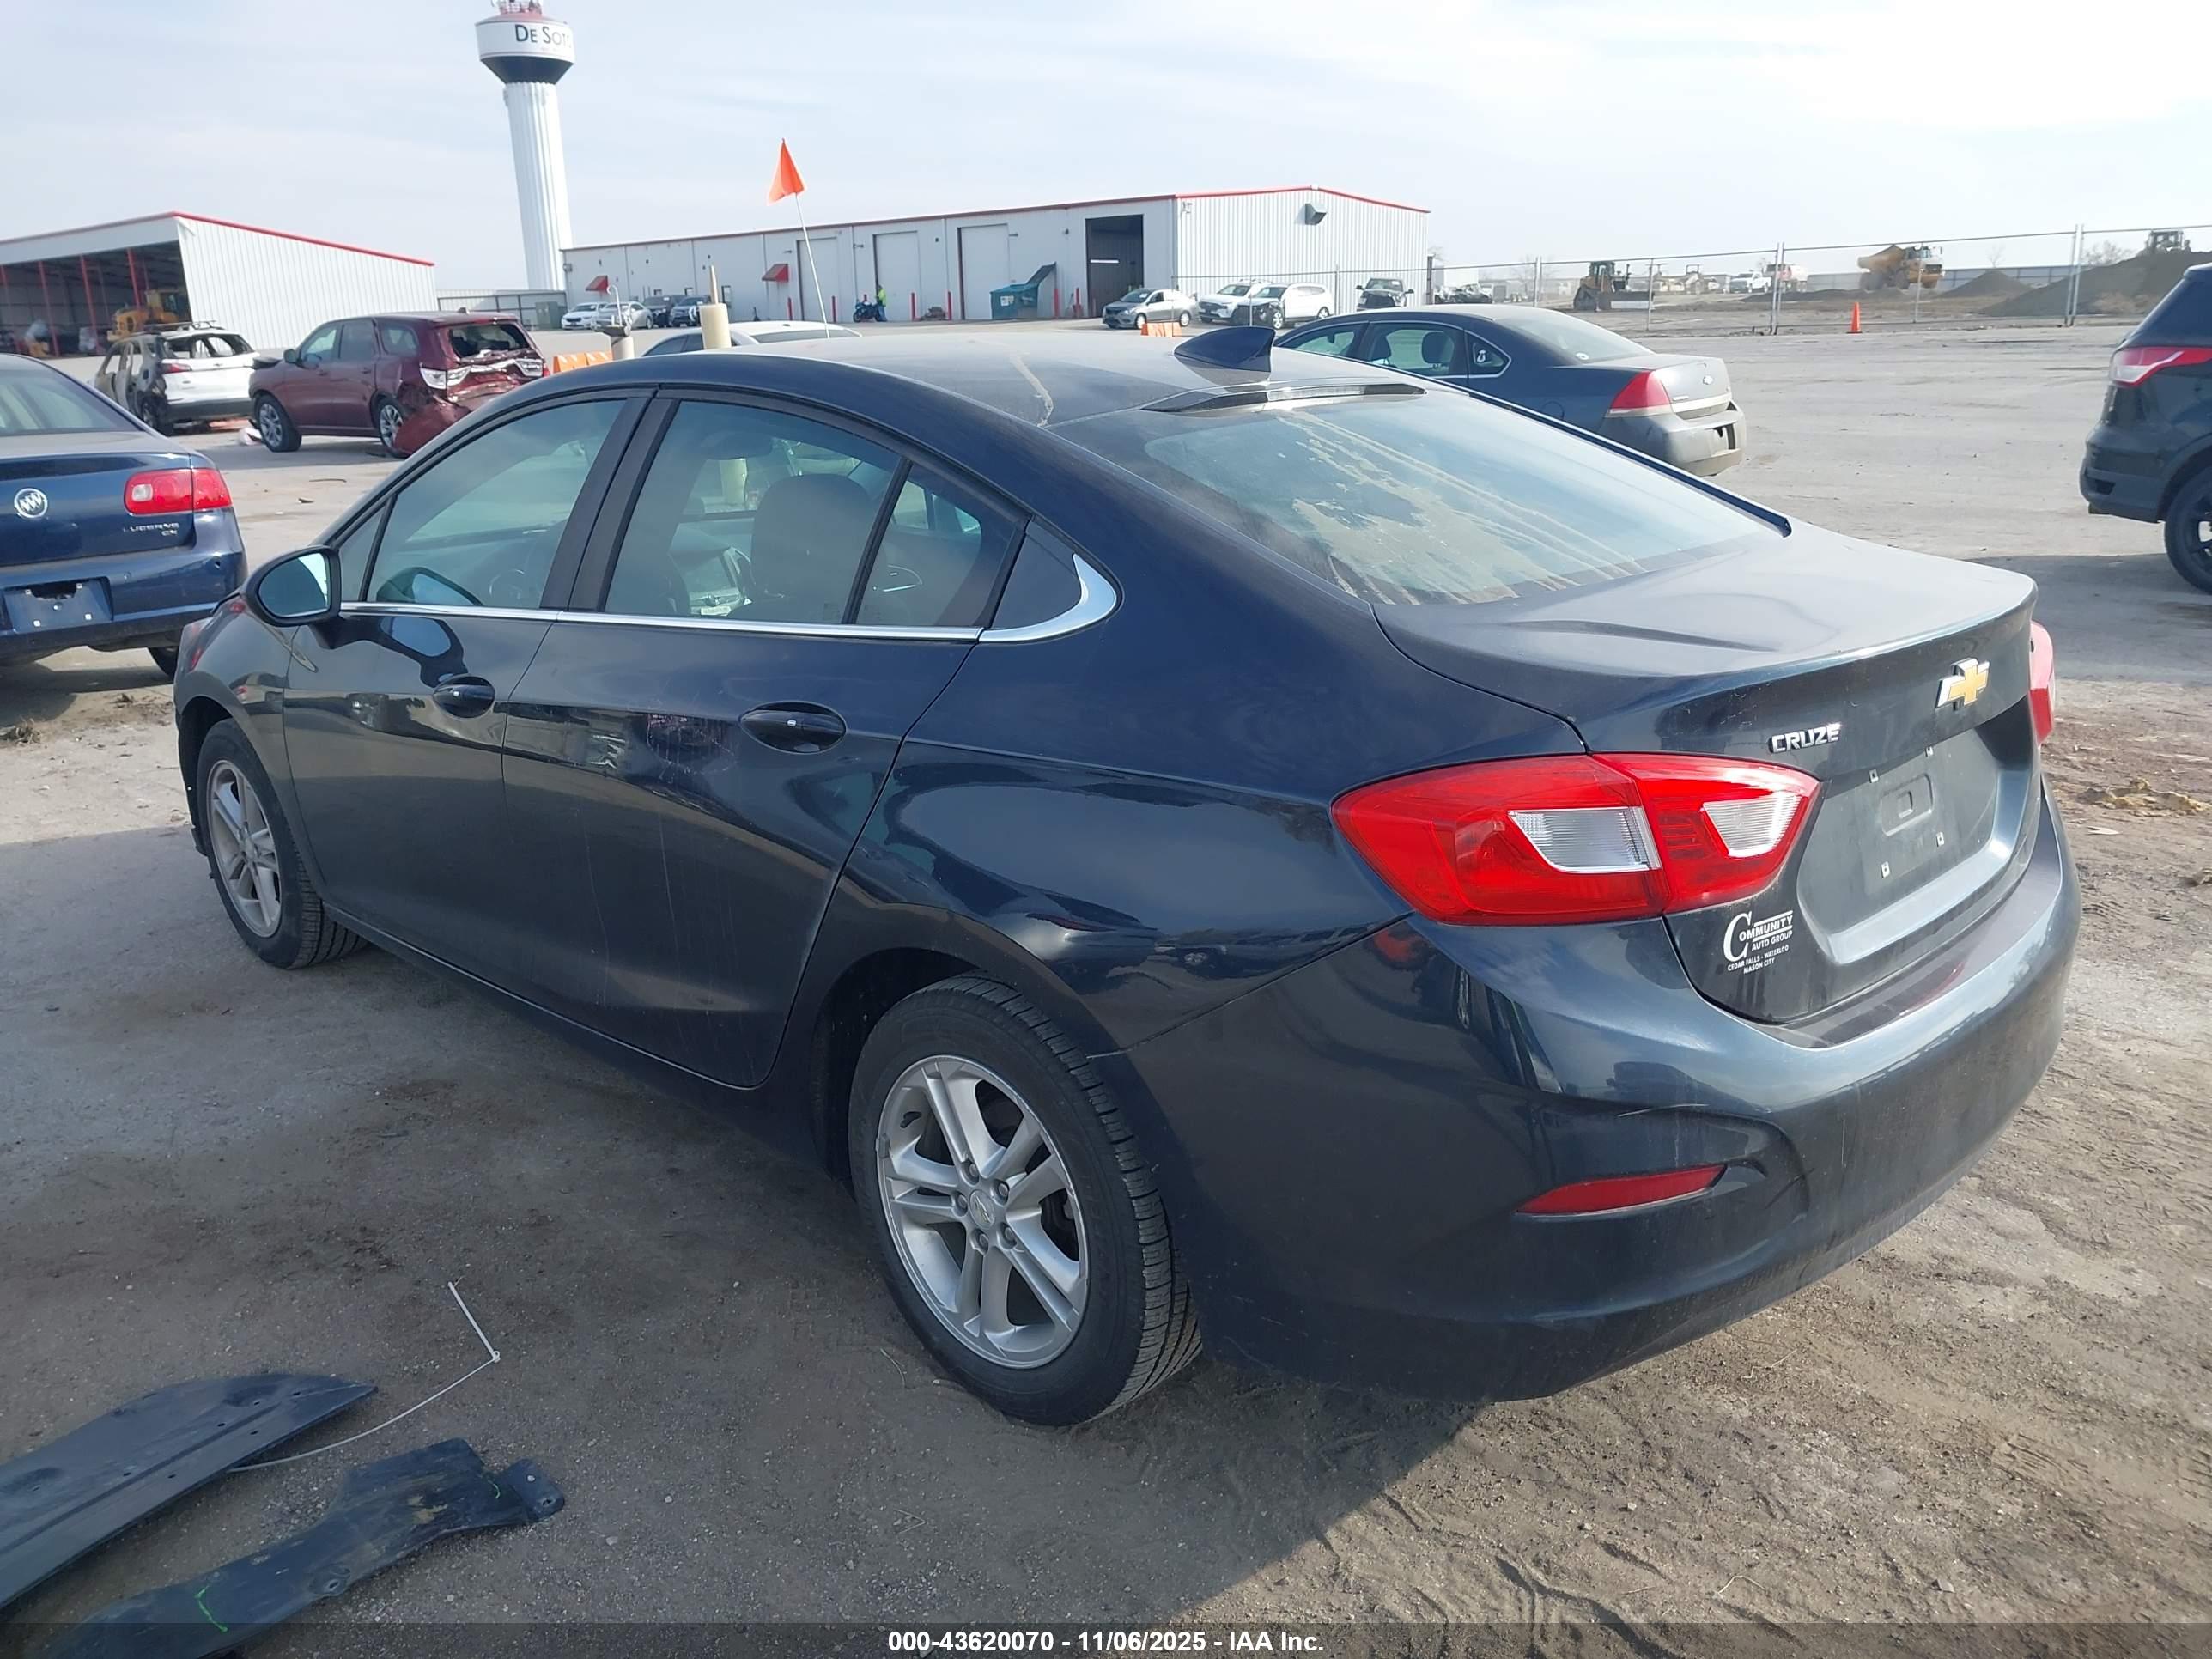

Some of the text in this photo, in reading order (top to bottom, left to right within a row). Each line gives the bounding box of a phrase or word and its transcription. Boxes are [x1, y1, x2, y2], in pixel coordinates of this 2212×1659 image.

[1769, 722, 1841, 753] CRUZE
[1752, 930, 1792, 951] AUTO GROUP
[1728, 961, 1745, 971] CEDAR
[1746, 955, 1760, 965] FALLS
[1764, 945, 1789, 958] WATERLOO
[1744, 957, 1775, 974] MASON CITY
